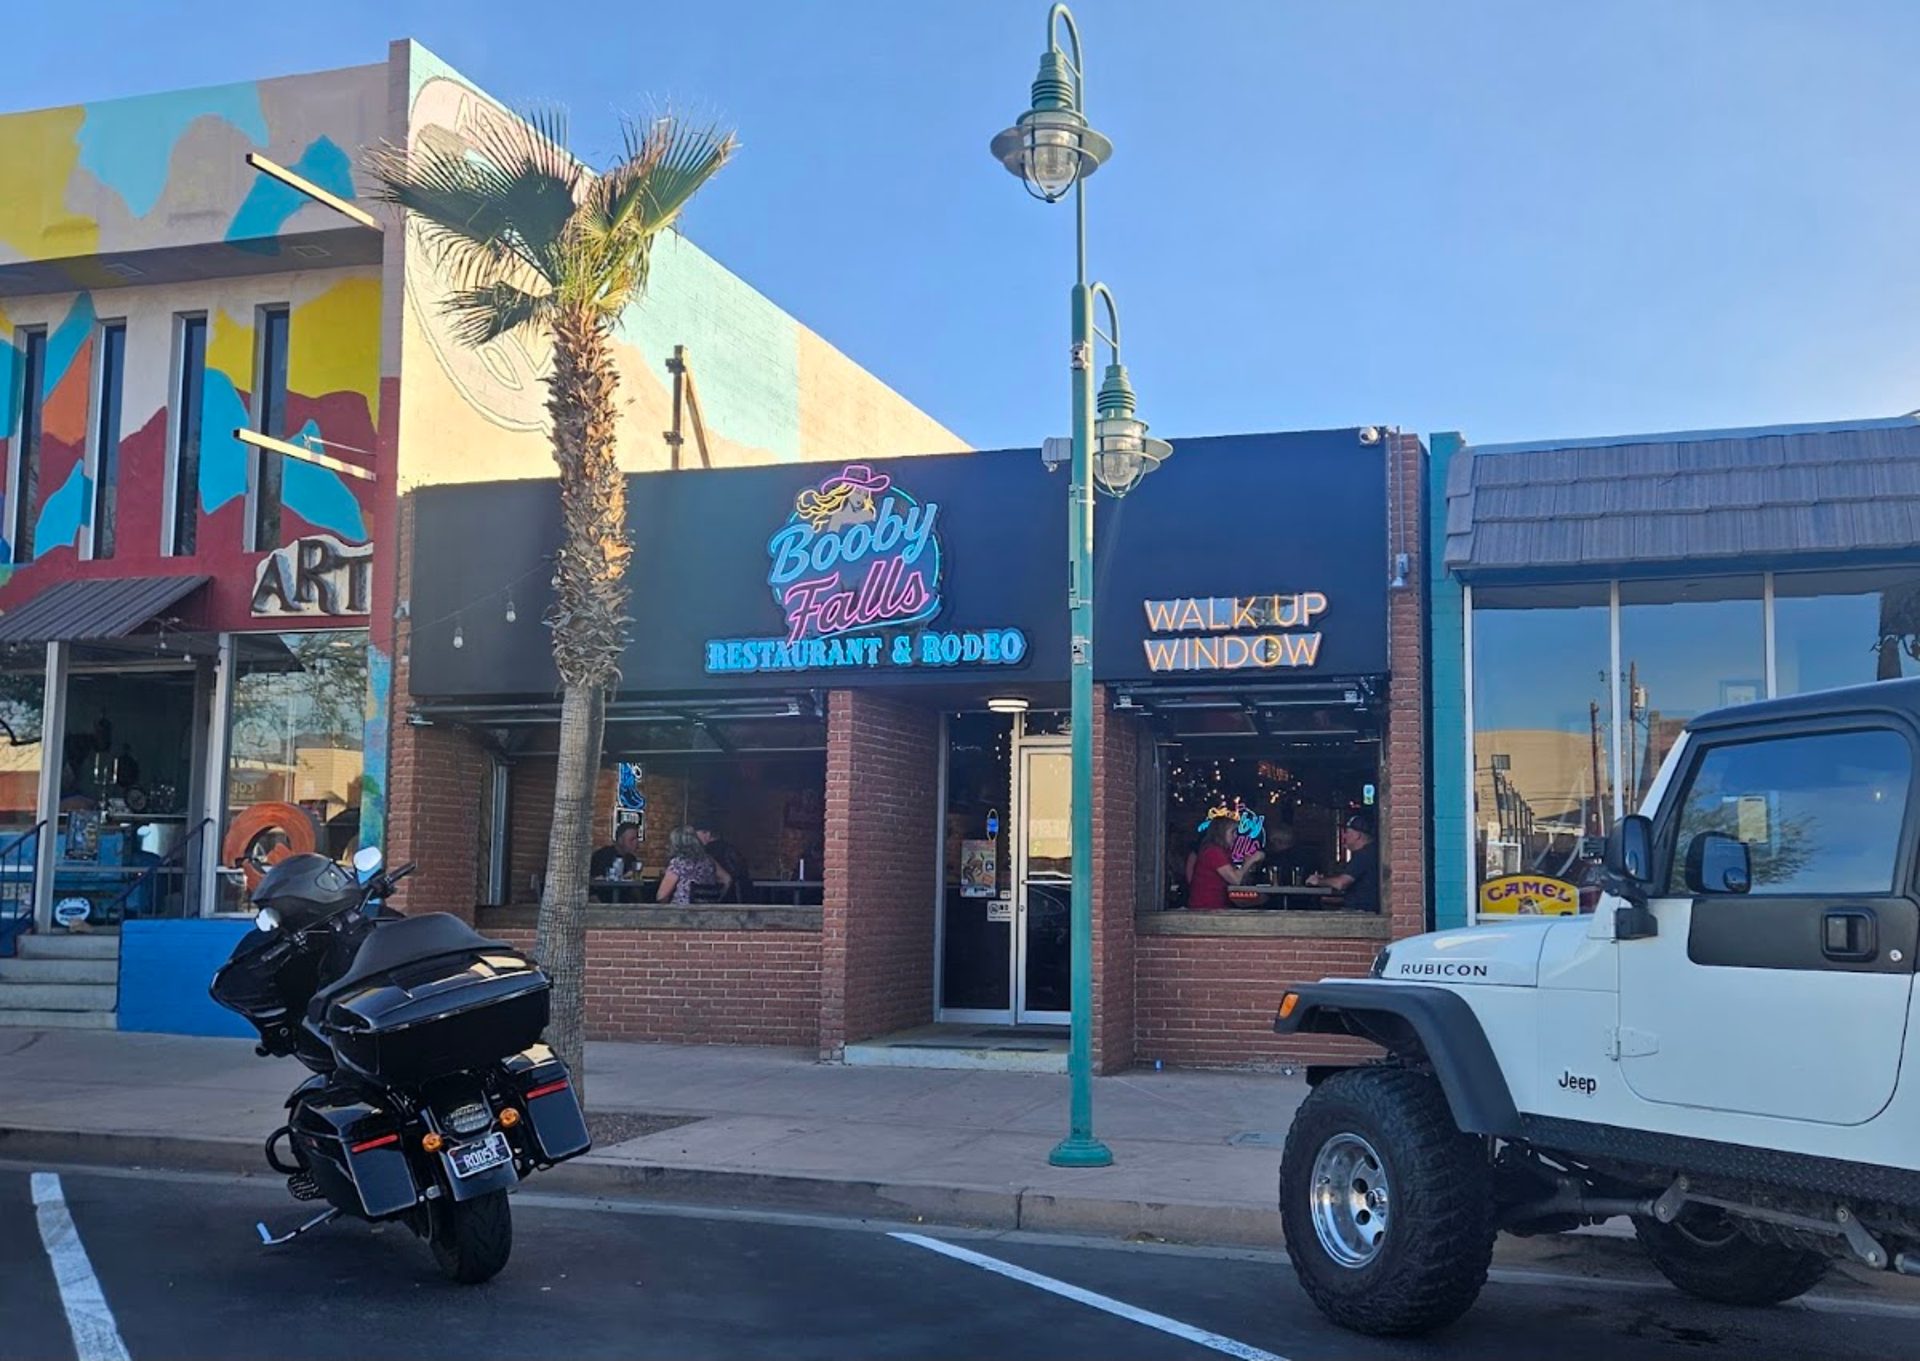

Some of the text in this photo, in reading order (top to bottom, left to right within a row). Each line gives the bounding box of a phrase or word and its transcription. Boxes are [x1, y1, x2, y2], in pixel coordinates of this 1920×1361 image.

[769, 497, 938, 584] Booby
[250, 539, 373, 615] ART
[784, 555, 930, 650] Falls
[1143, 592, 1328, 632] WALK UP
[708, 629, 1026, 670] RESTAURANT & RODEO
[1143, 631, 1322, 672] WINDOW
[1487, 881, 1572, 903] CAMEL
[1400, 963, 1488, 978] RUBICON
[1557, 1070, 1597, 1095] Jeep
